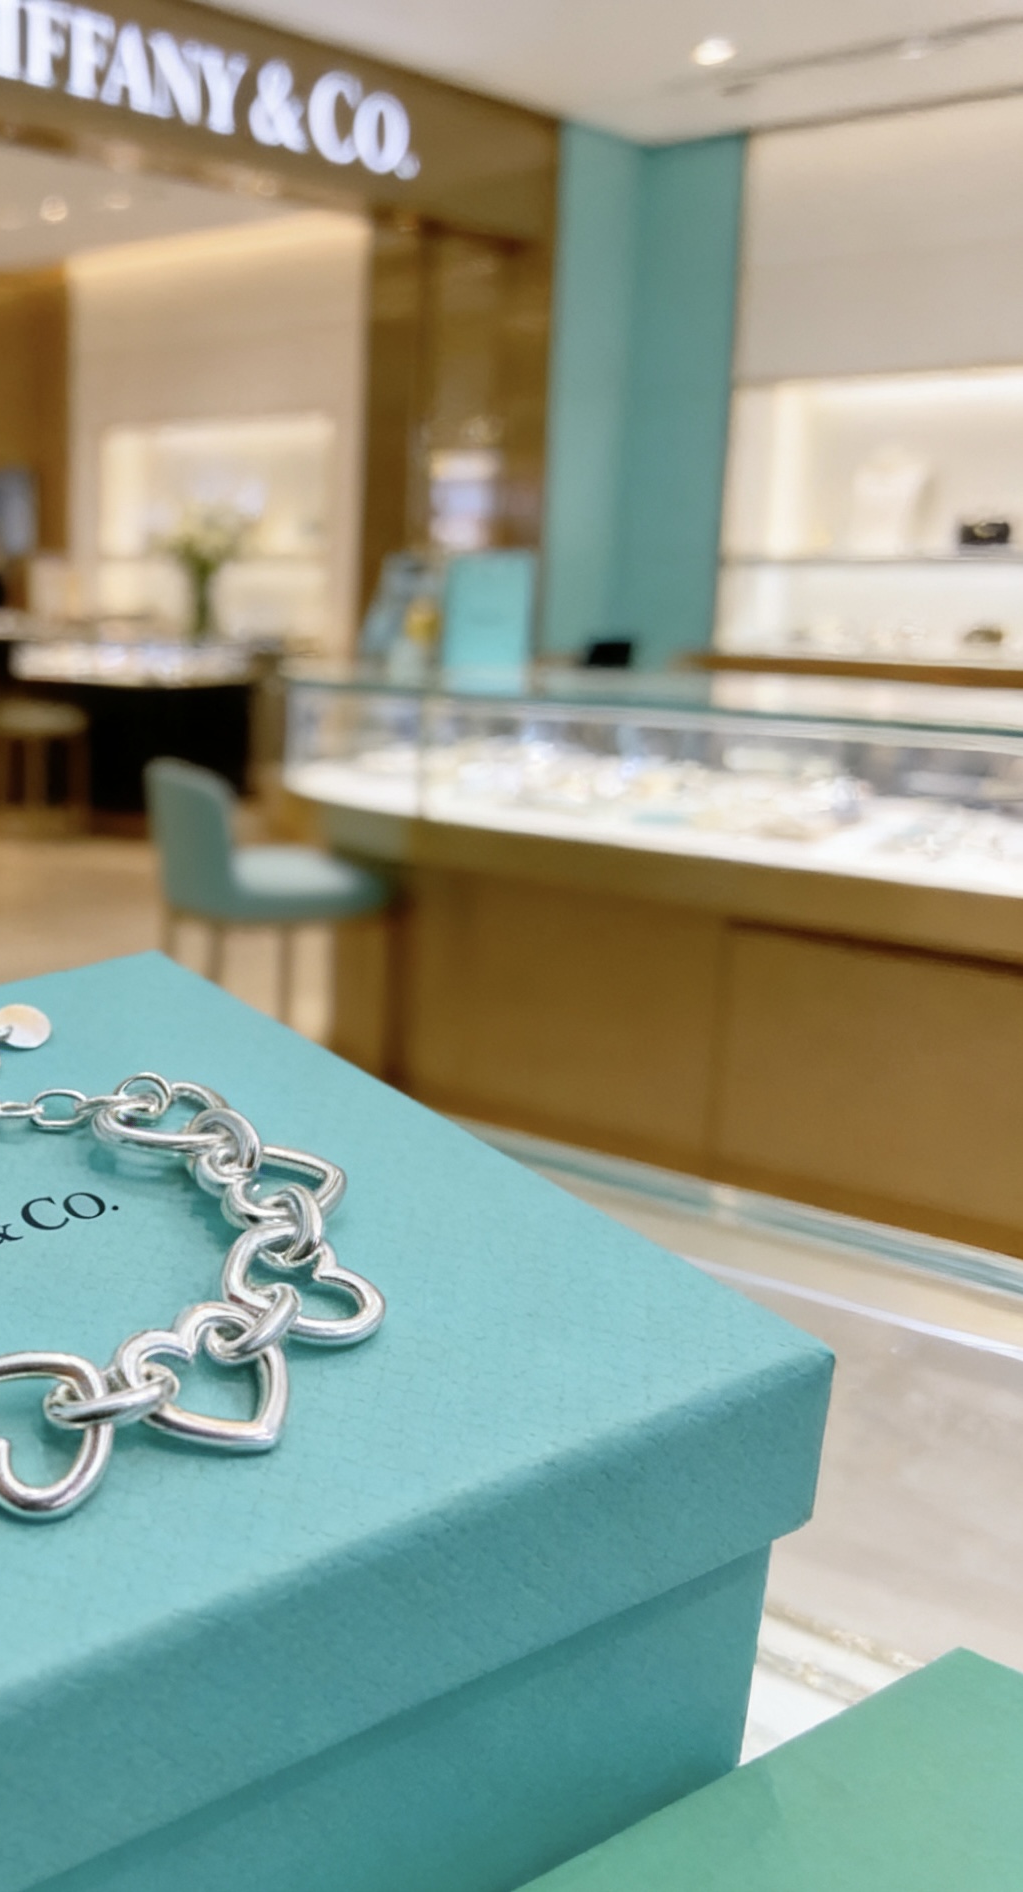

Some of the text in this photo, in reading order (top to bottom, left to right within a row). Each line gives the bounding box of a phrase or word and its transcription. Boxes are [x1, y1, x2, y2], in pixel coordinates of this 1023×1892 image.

[248, 58, 308, 153] &
[308, 70, 420, 180] CO.
[20, 1191, 120, 1231] CO.
